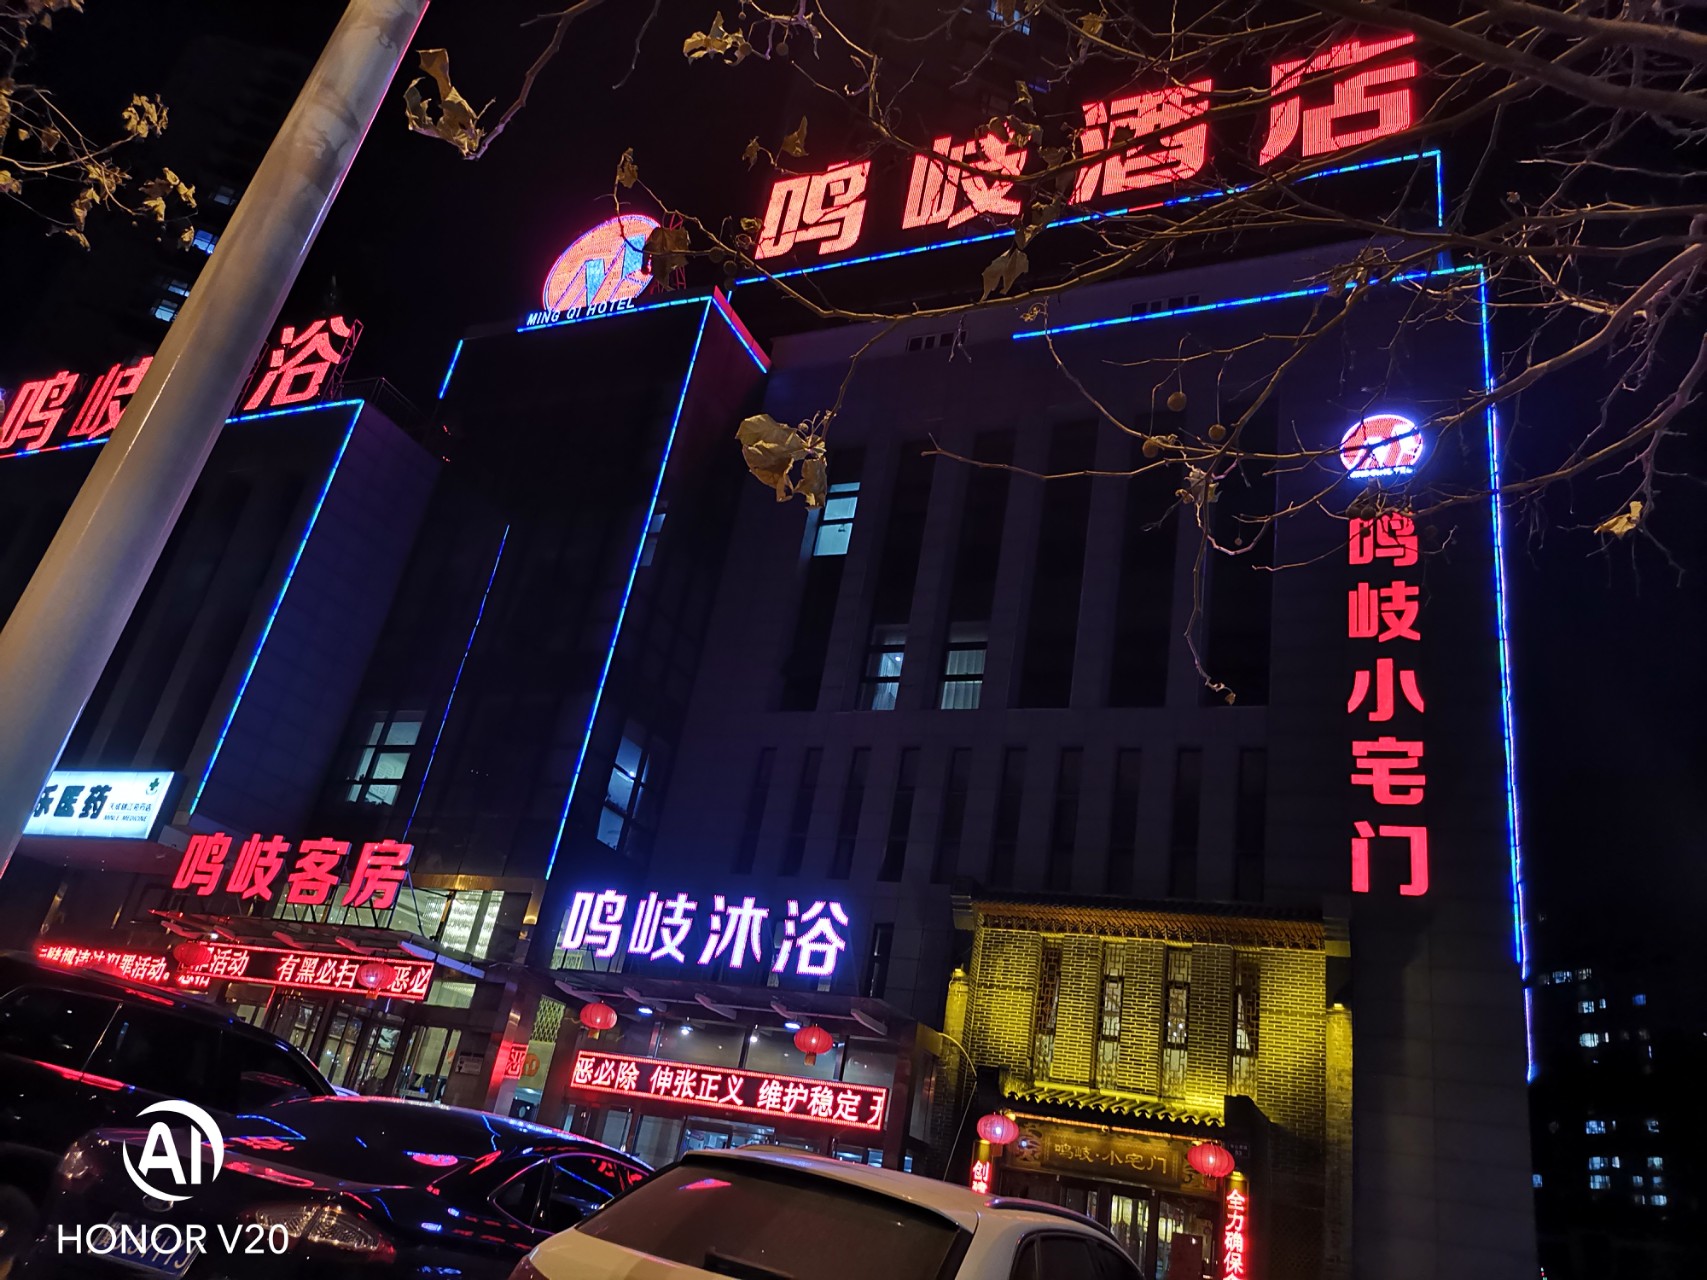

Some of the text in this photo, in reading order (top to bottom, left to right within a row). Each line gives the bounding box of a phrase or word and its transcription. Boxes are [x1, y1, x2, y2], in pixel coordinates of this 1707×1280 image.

[754, 32, 1419, 262] 鸣岐酒店
[526, 297, 635, 326] MING QI HOTEL
[1347, 510, 1430, 897] 鸣岐小宅门
[172, 832, 415, 910] 鸣岐客房
[561, 889, 849, 976] 鸣岐沐浴
[276, 954, 360, 988] 有黑必扫
[379, 965, 430, 994] 恶必
[575, 1057, 640, 1091] 恶必除
[650, 1065, 745, 1107] 伸张正义
[756, 1079, 861, 1121] 维护稳定
